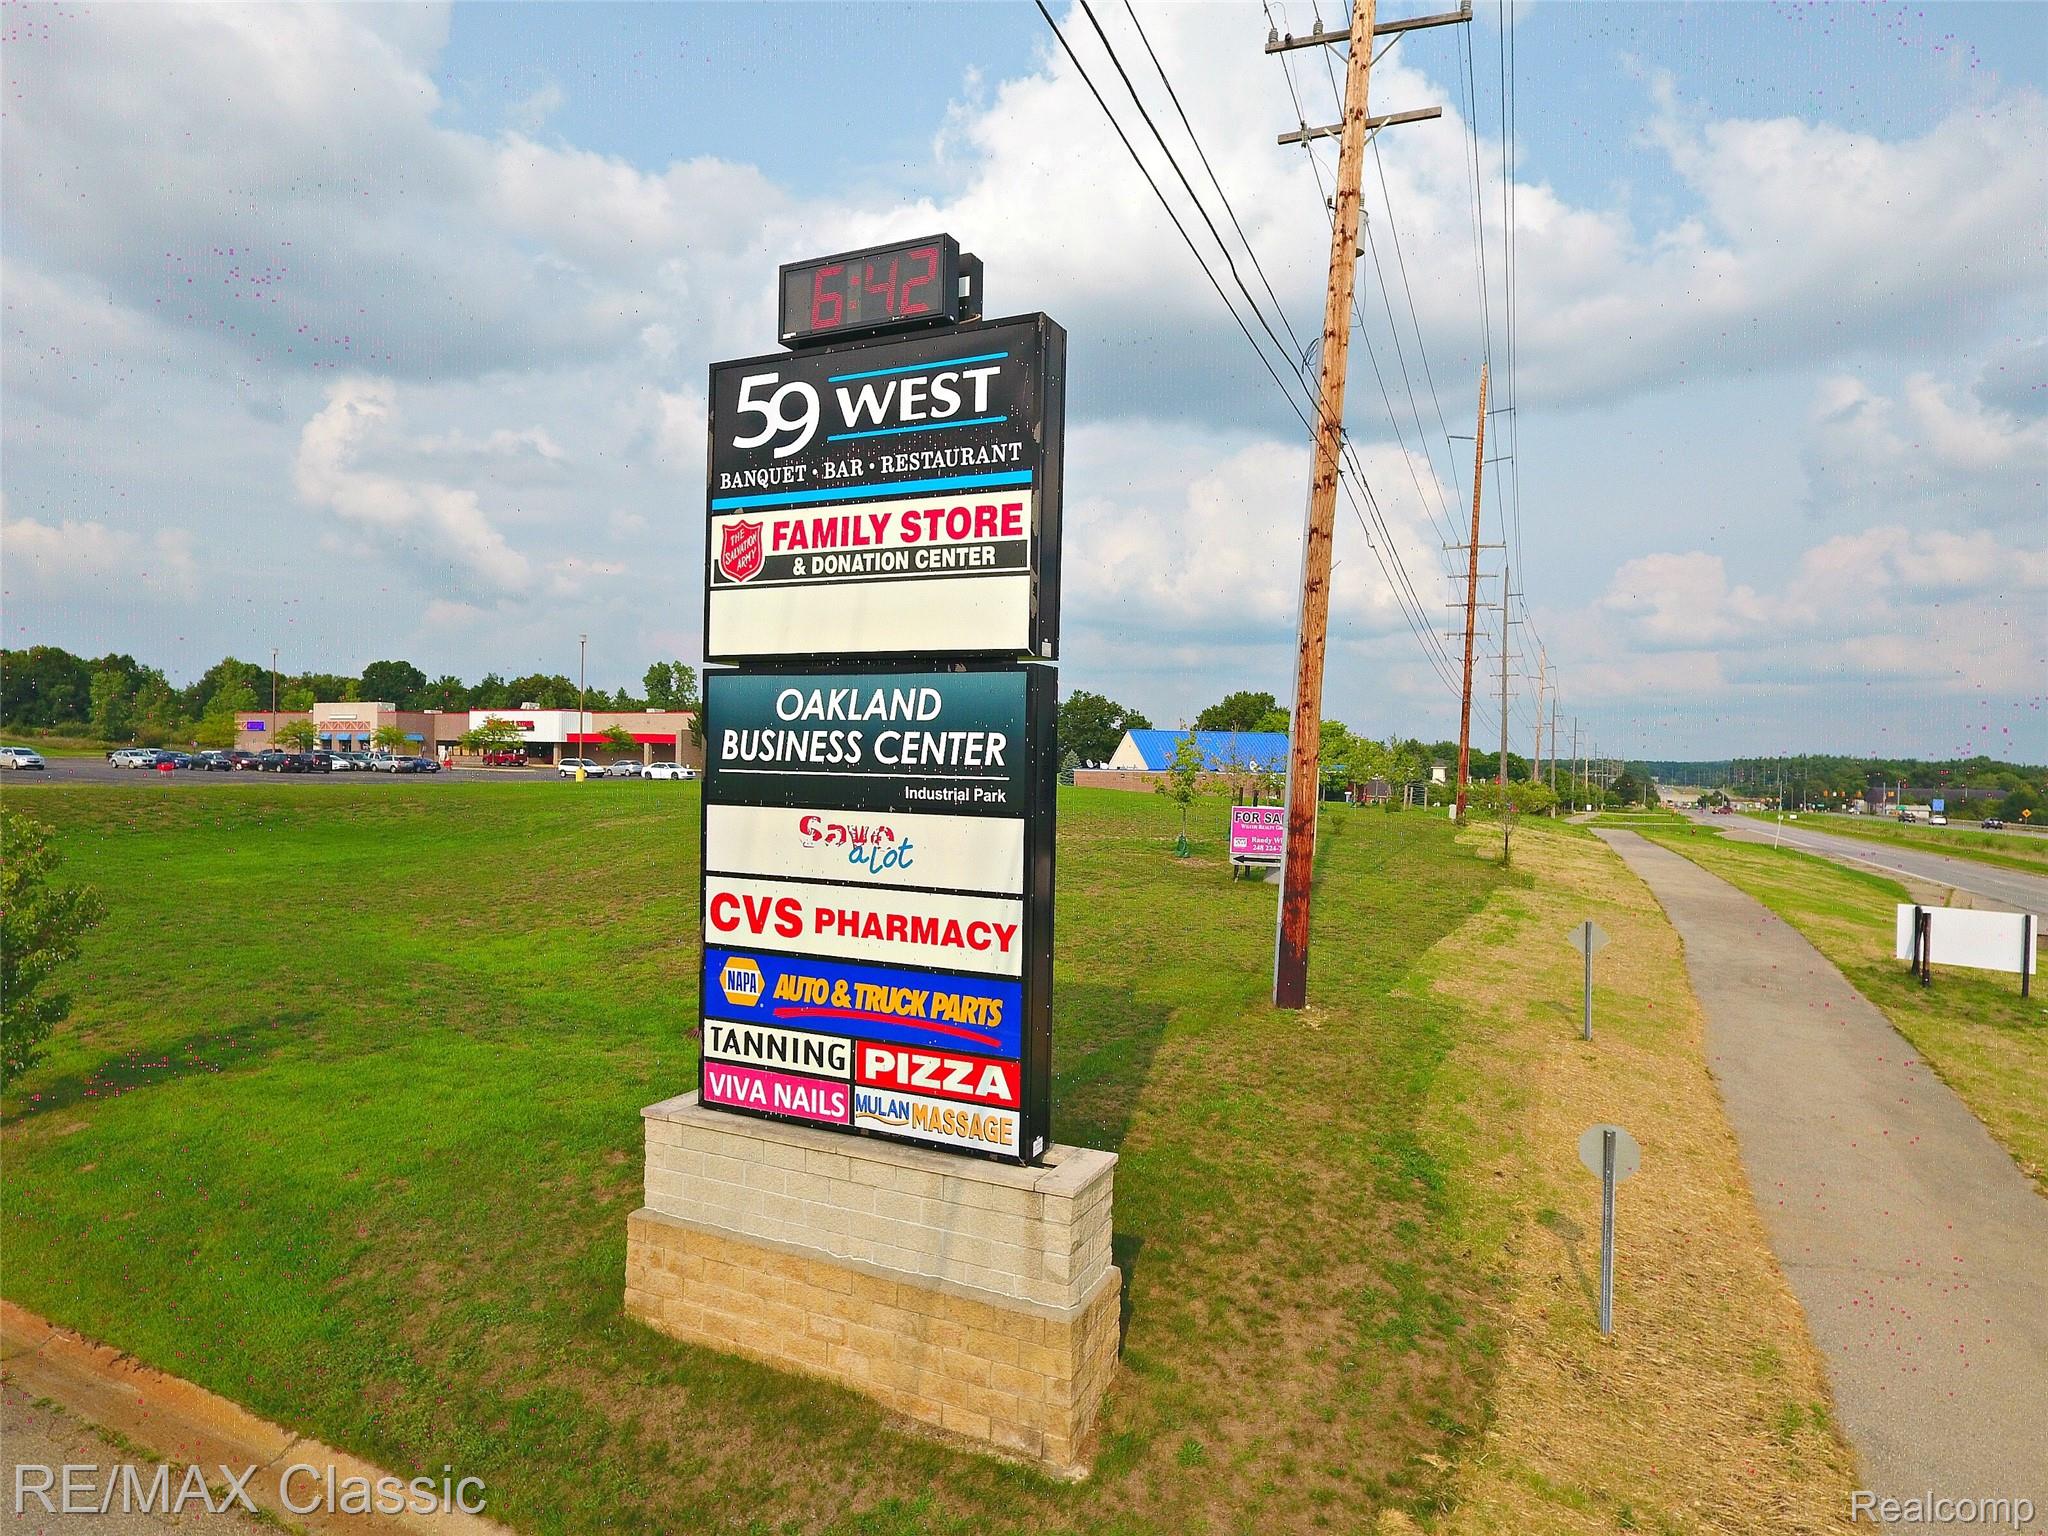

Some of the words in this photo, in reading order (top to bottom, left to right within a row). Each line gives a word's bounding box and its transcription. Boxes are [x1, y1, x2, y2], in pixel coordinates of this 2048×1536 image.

[732, 372, 820, 459] 59
[836, 366, 1001, 428] WEST
[720, 464, 807, 489] BANQUET
[824, 459, 864, 479] BAR
[880, 442, 1023, 474] RESTAURANT
[731, 529, 745, 546] THE
[772, 513, 892, 551] FAMILY
[900, 502, 1024, 543] STORE
[725, 531, 758, 565] SALVATION
[737, 547, 757, 572] ARMY
[792, 557, 807, 576] &
[811, 551, 910, 575] DONATION
[915, 545, 996, 568] CENTER
[775, 688, 942, 721] OAKLAND
[721, 729, 863, 765] BUSINESS
[874, 730, 1008, 766] CENTER
[904, 785, 970, 802] Industrial
[973, 787, 1007, 803] Park
[1235, 812, 1260, 823] FOR
[710, 892, 804, 938] CVS
[814, 908, 1018, 953] PHARMACY
[725, 970, 757, 995] NAPA
[774, 973, 829, 1006] AUTO
[831, 979, 851, 1008] &
[852, 982, 929, 1018] TRUCK
[931, 993, 1004, 1028] PARTS
[710, 1026, 846, 1071] TANNING
[709, 1072, 767, 1103] VIVA
[774, 1081, 845, 1118] NAILS
[865, 1049, 1013, 1100] PIZZA
[855, 1093, 910, 1120] MULAN
[912, 1104, 1013, 1146] MASSAGE
